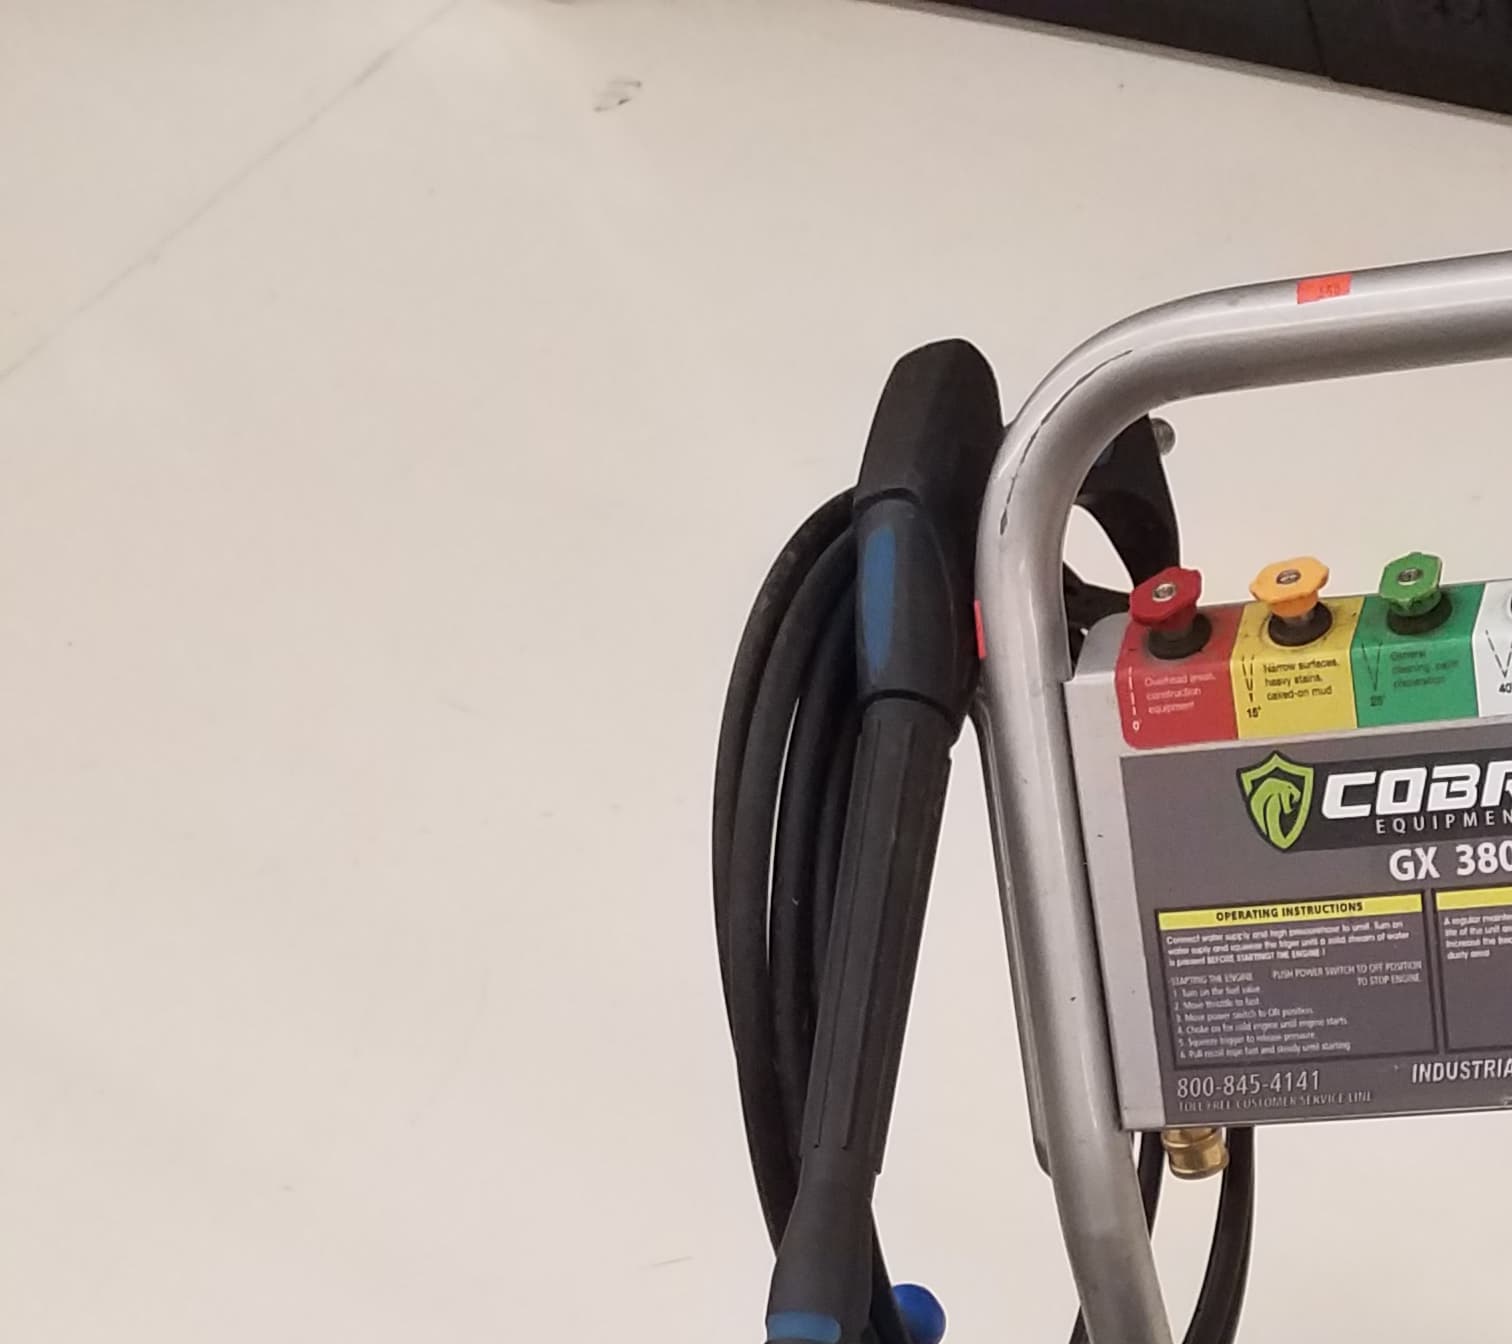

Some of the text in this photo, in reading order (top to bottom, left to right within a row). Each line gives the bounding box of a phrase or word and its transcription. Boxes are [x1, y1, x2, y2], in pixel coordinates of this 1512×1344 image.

[1263, 662, 1295, 673] Narrow
[1144, 676, 1188, 687] Overhead
[1265, 677, 1291, 687] heavy
[1146, 688, 1201, 700] construction
[1311, 685, 1332, 696] mud
[1148, 701, 1194, 714] equipment
[1389, 846, 1440, 881] GX
[1216, 901, 1363, 922] OPERATING INSTRUCTIONS
[1252, 931, 1268, 939] and
[1212, 944, 1229, 953] and
[1294, 967, 1323, 977] POWER
[1356, 964, 1367, 974] TO
[1369, 975, 1389, 985] STOP
[1177, 1070, 1320, 1098] 800-845-4141
[1235, 1096, 1297, 1109] CUSTOMER
[1299, 1093, 1344, 1106] SERVICE
